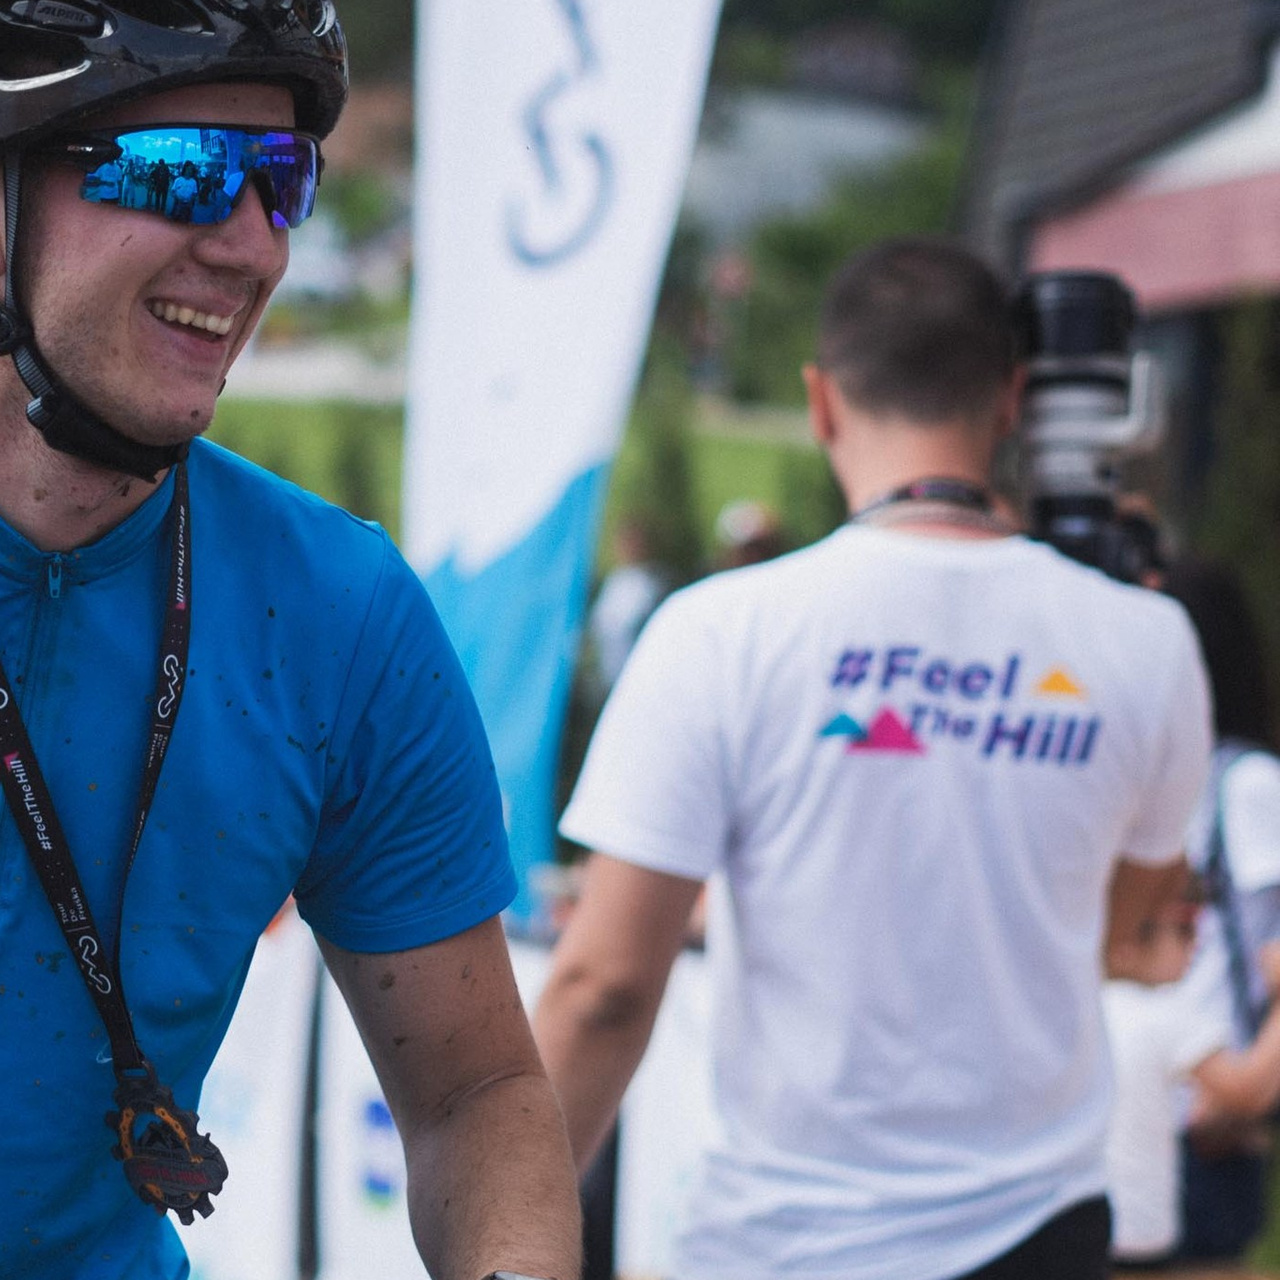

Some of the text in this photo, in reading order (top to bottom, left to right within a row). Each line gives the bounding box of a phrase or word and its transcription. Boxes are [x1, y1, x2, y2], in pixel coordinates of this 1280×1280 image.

[830, 647, 1019, 699] #Feel
[982, 713, 1098, 765] Hill
[10, 760, 52, 851] #FeelTheHill
